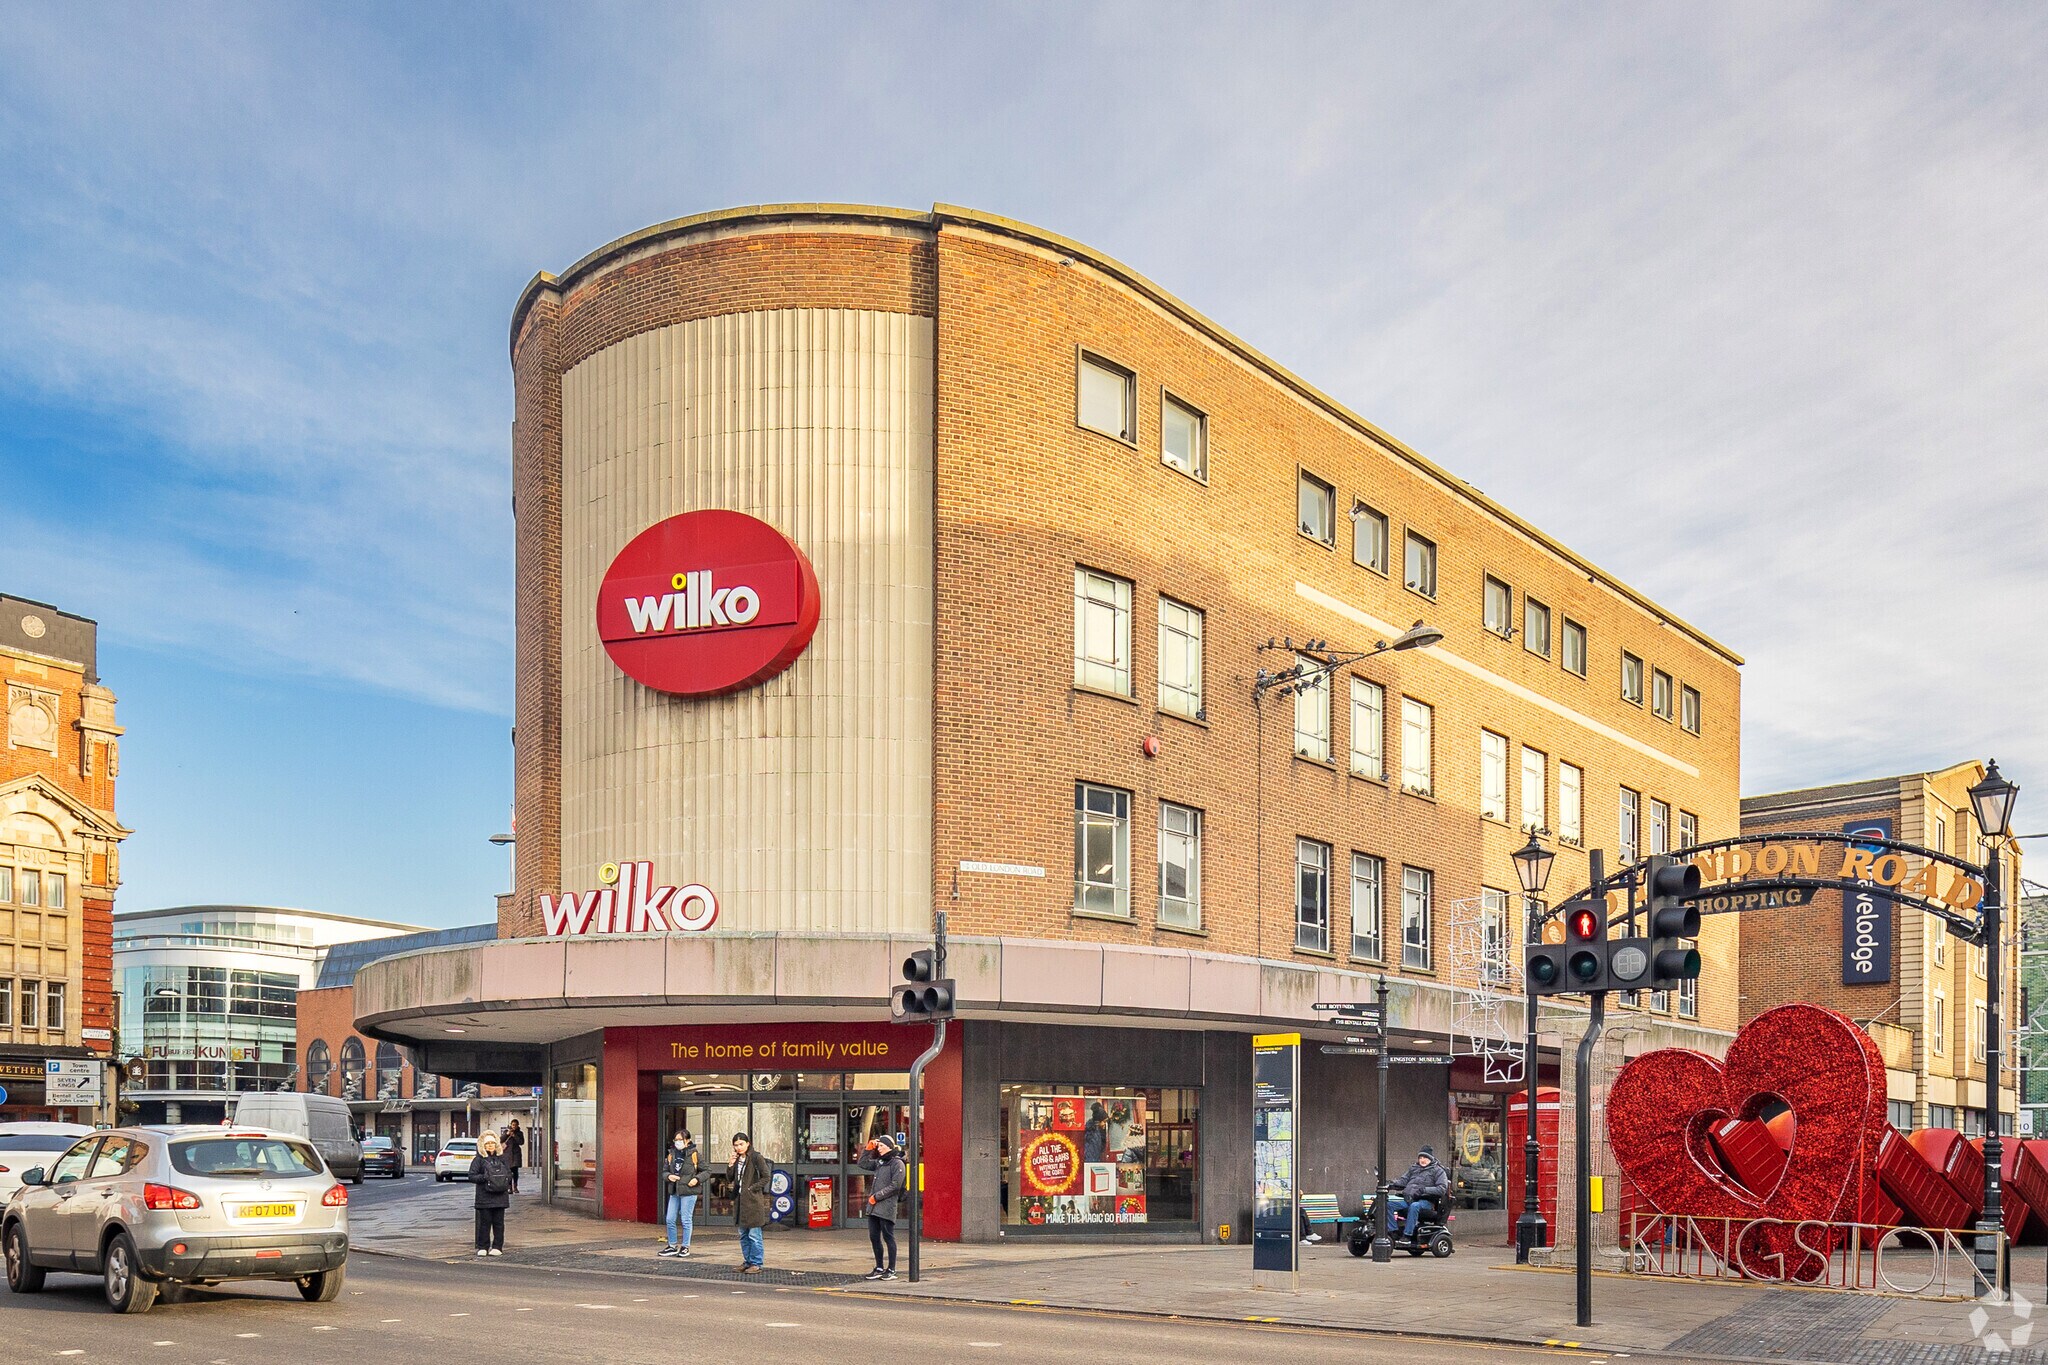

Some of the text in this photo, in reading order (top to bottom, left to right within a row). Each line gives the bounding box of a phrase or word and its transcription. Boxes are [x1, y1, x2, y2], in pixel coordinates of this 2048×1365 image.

[624, 570, 760, 633] wilko
[17, 848, 47, 865] 1910
[971, 863, 1043, 876] OLD LONDON ROAD
[1837, 847, 1983, 910] ROAD
[540, 861, 719, 936] wilko
[1850, 865, 1880, 974] avelodge
[243, 1048, 260, 1061] FU
[671, 1040, 889, 1060] The home of family value
[1038, 1144, 1062, 1155] ALL THE
[1032, 1152, 1070, 1165] OOHS & AAHS
[239, 1205, 296, 1217] KF07 UDM
[1045, 1213, 1066, 1224] MAKE
[1067, 1213, 1080, 1223] THE
[1081, 1213, 1104, 1223] MAGIC
[1104, 1213, 1115, 1223] GO
[1631, 1212, 2005, 1301] KINGSTON
